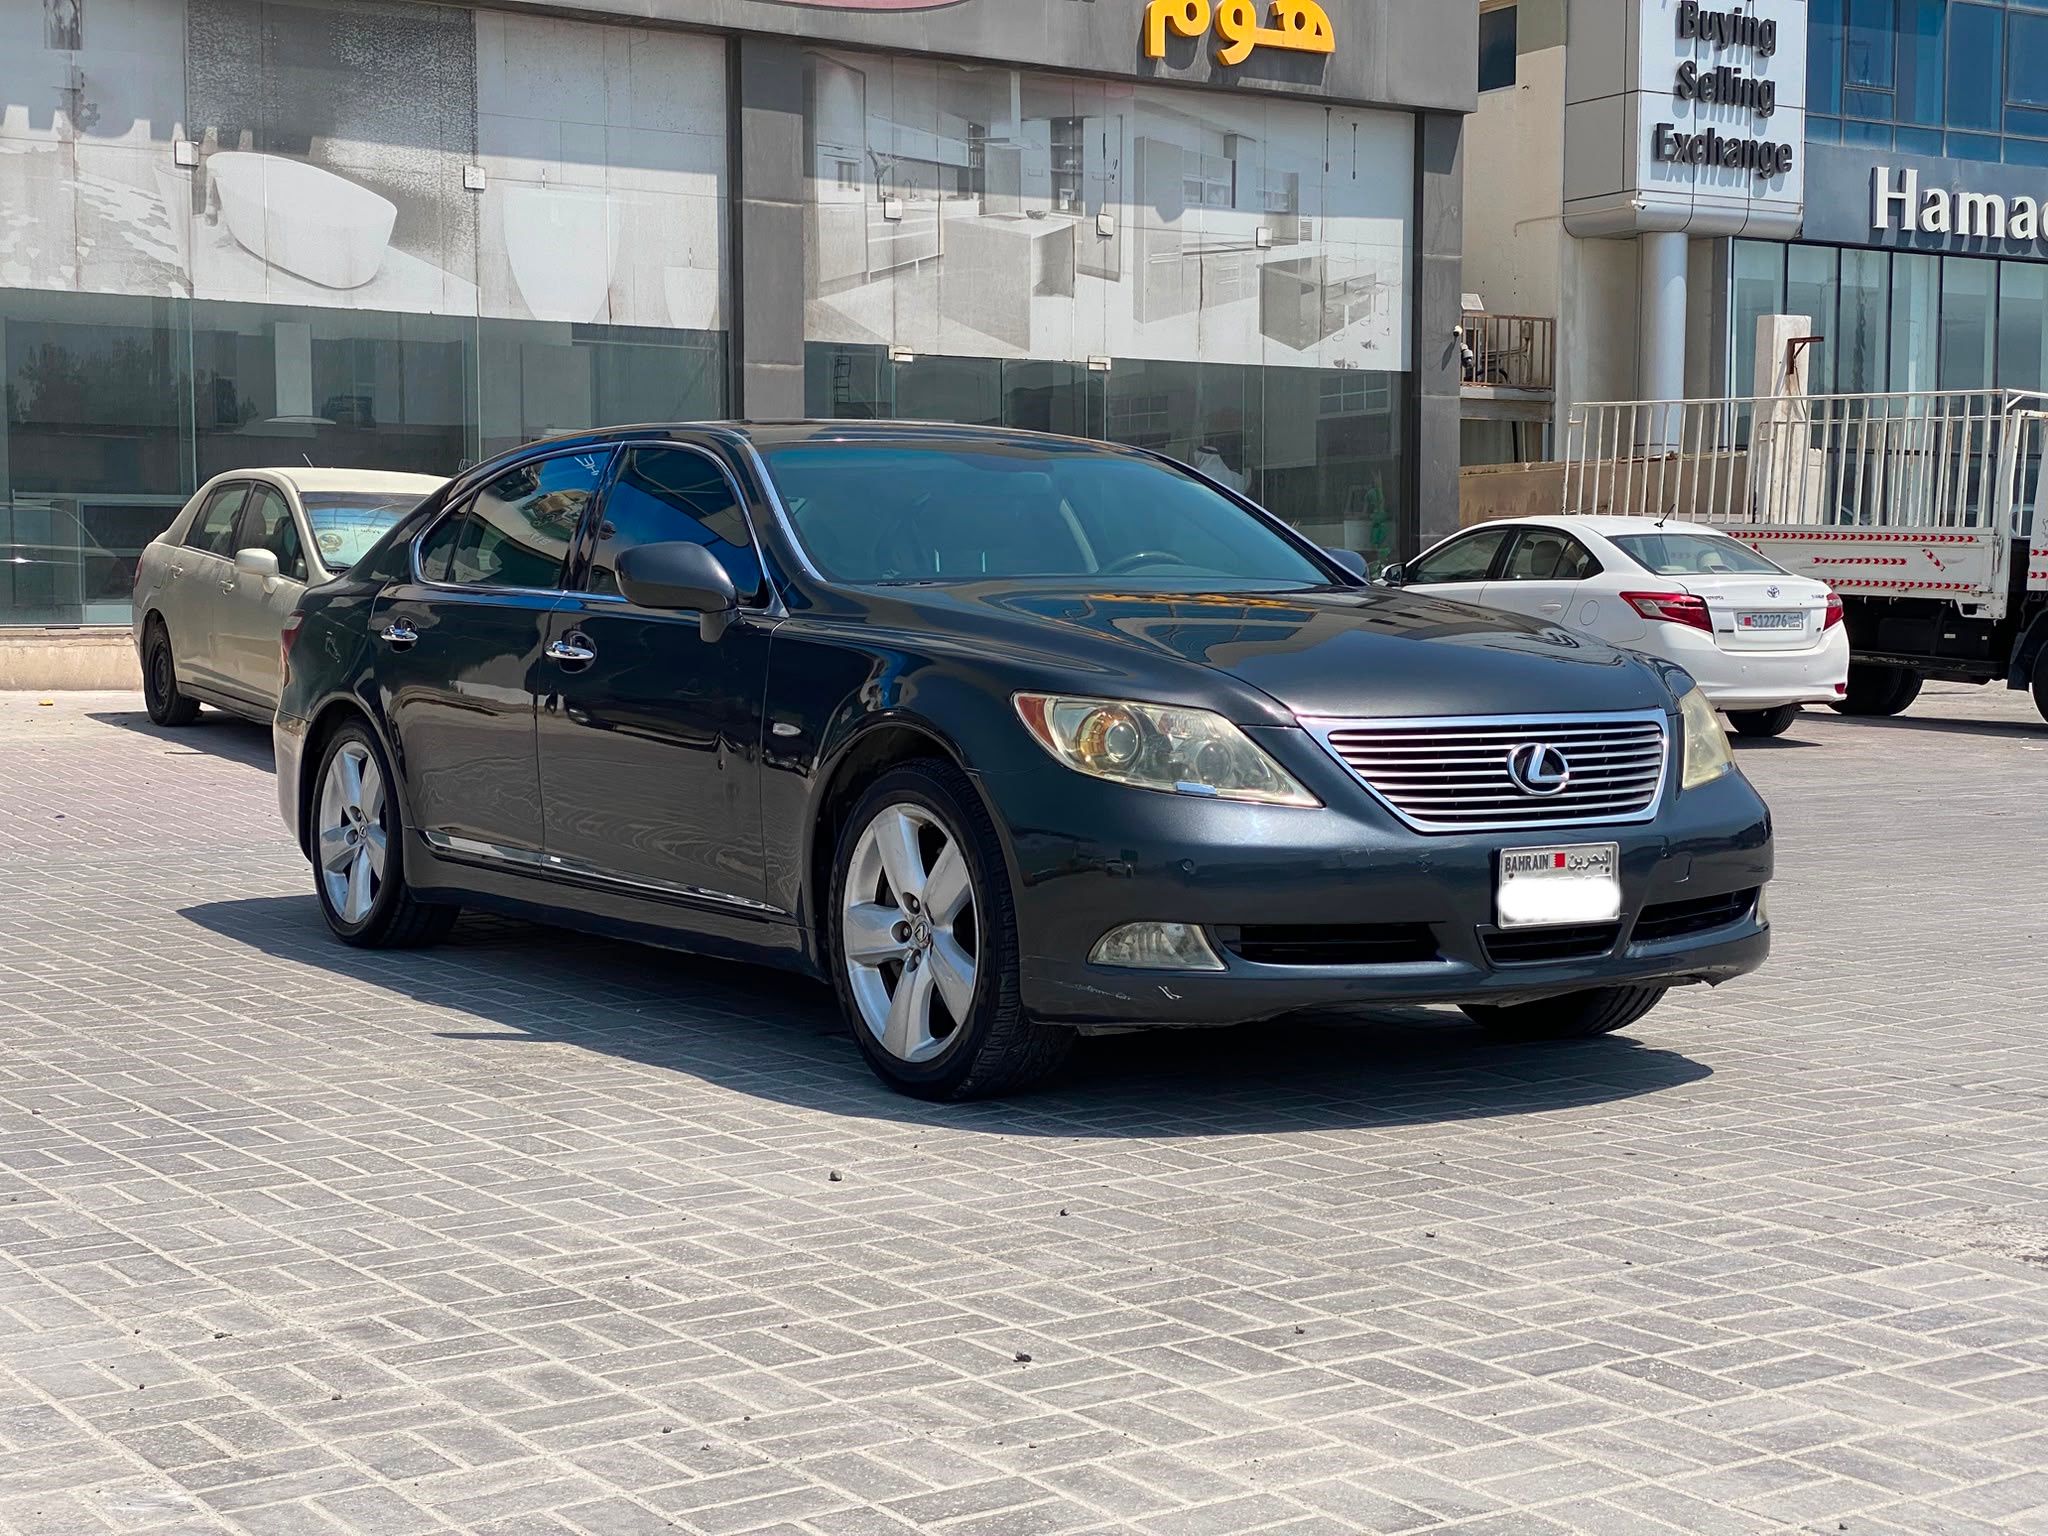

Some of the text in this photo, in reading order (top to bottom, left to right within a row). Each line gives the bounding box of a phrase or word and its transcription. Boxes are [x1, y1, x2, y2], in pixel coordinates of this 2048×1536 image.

[1144, 0, 1336, 66] هوم
[1680, 0, 1777, 57] Buying
[1677, 60, 1776, 118] Selling
[1655, 123, 1793, 180] Exchange
[1751, 614, 1788, 628] 512276
[1504, 853, 1549, 872] BAHRAIN
[1567, 849, 1612, 870] البحرين
